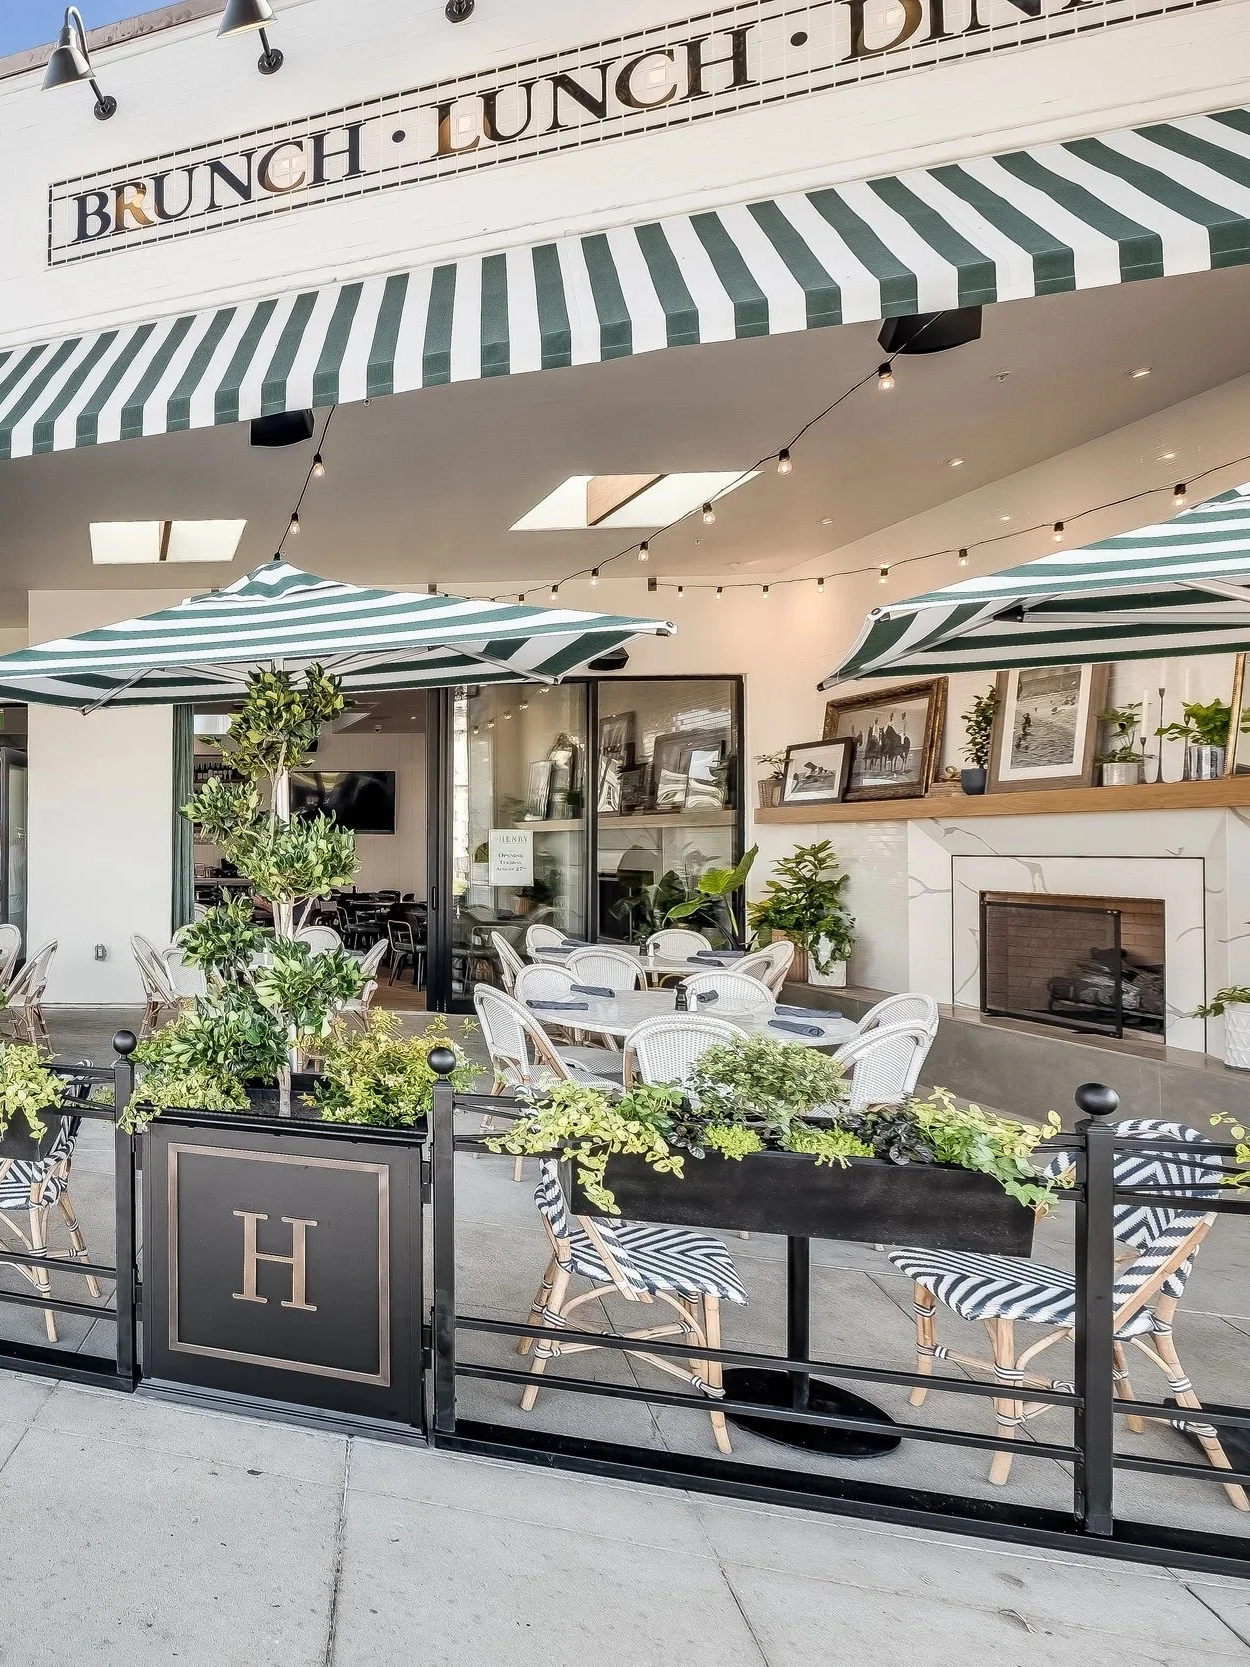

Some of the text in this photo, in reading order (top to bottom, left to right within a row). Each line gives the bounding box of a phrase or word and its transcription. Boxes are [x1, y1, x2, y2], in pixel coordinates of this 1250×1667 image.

[71, 122, 367, 244] BRUNCH
[430, 25, 757, 158] LUNCH
[232, 1209, 318, 1312] H
